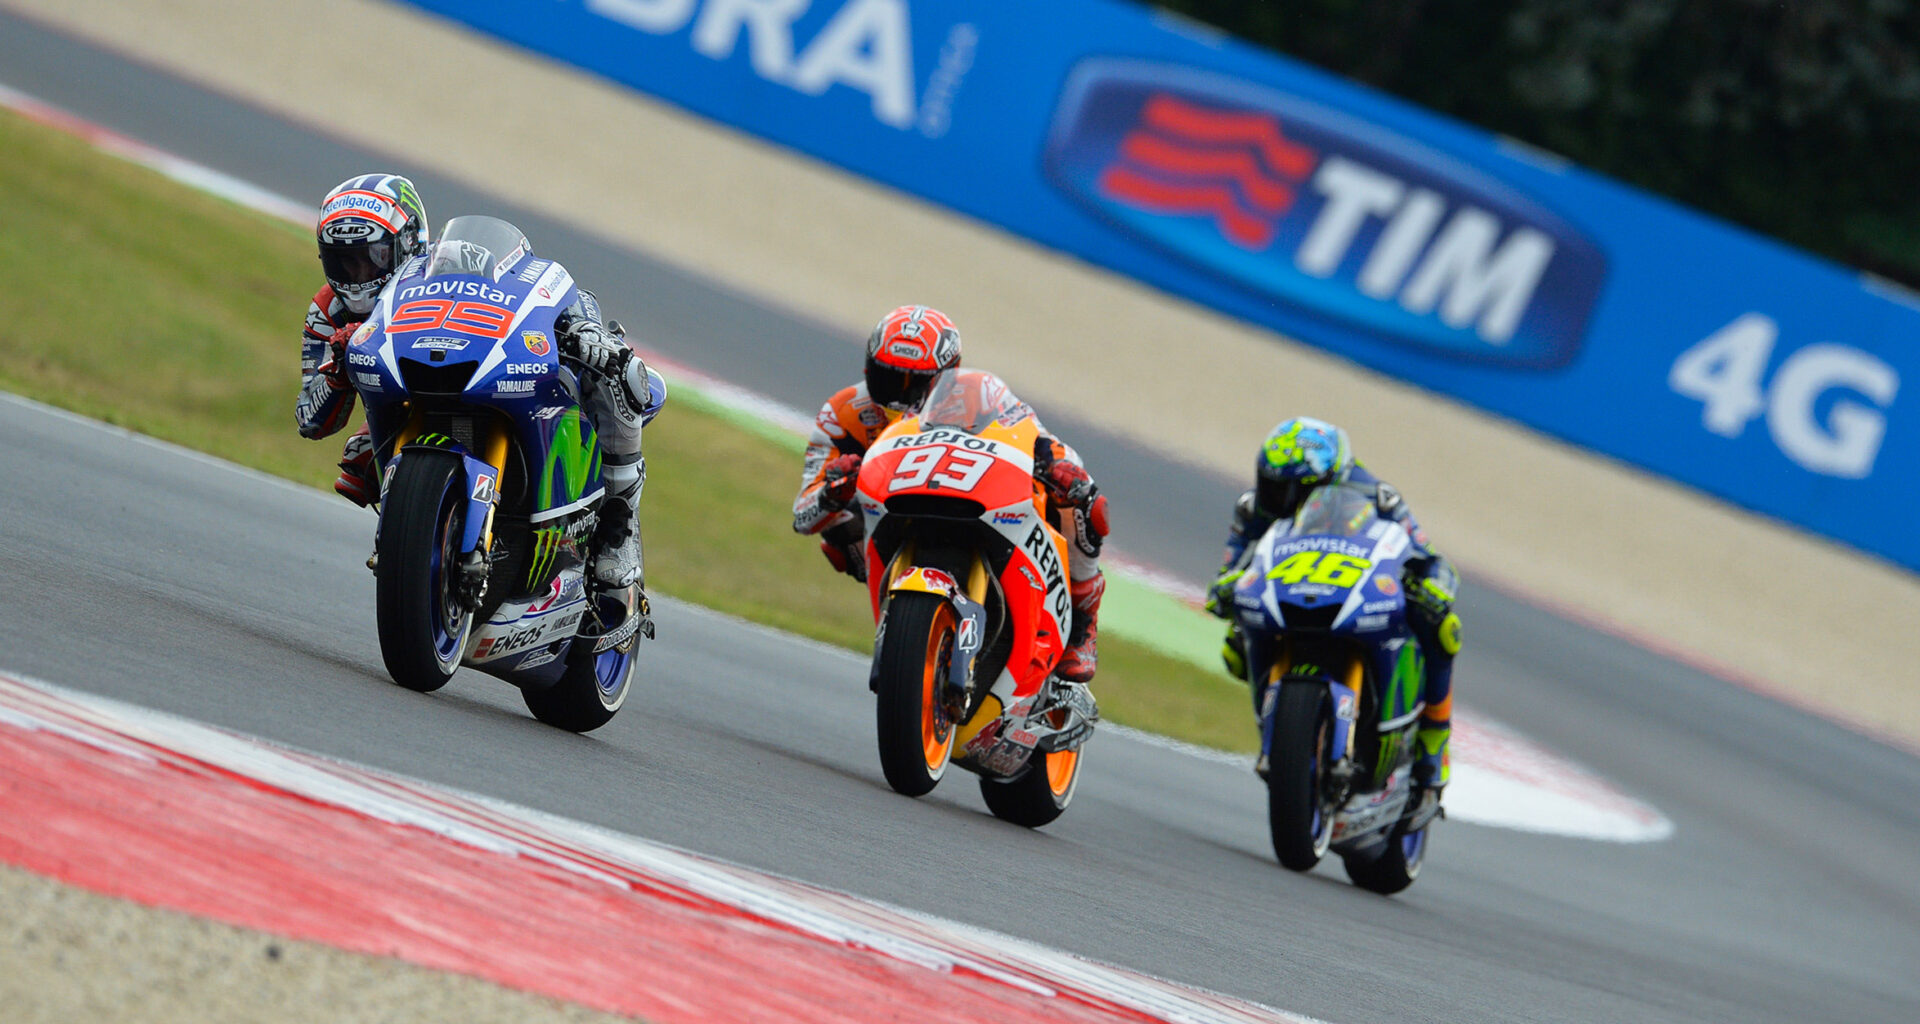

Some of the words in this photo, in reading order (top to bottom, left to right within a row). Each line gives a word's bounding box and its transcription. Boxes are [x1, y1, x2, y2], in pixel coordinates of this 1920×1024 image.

[326, 195, 382, 213] sterilgarda
[331, 227, 366, 235] HJC
[1294, 154, 1556, 347] TIM
[360, 273, 393, 289] SECTOR
[400, 280, 517, 306] movistar
[384, 299, 516, 339] 99
[349, 353, 377, 367] ENEOS
[506, 363, 549, 375] ENEOS
[496, 380, 537, 393] YAMALUBE
[1668, 311, 1900, 479] 4G
[893, 430, 998, 455] REPSOL
[888, 444, 995, 493] 93
[1274, 537, 1369, 559] movistar
[1025, 523, 1067, 634] REPSOL
[1266, 551, 1372, 588] 46
[488, 624, 547, 656] ENEOS
